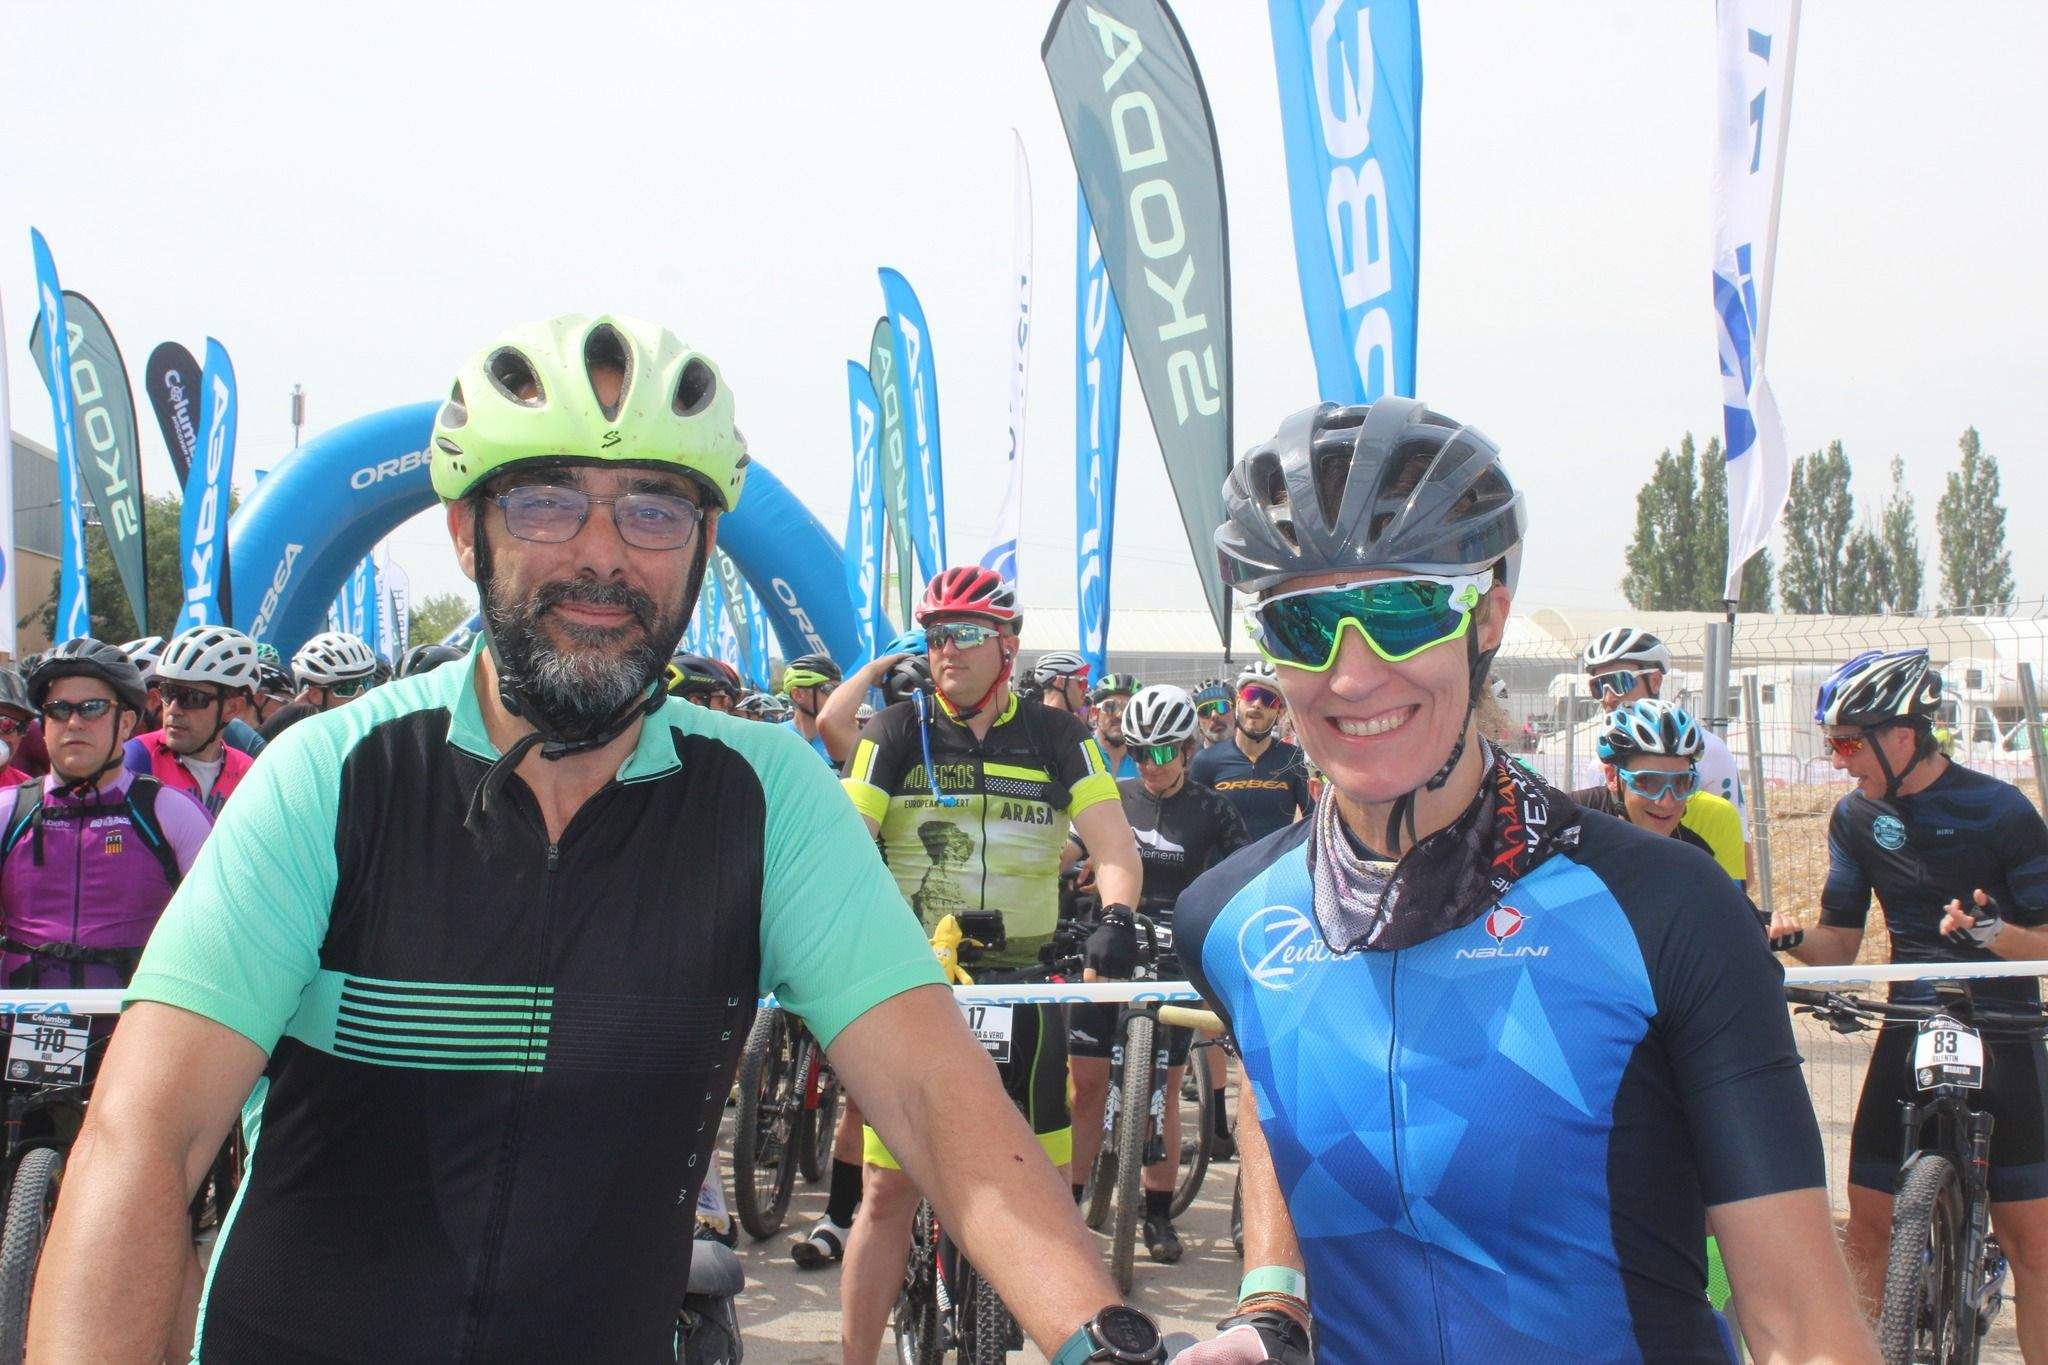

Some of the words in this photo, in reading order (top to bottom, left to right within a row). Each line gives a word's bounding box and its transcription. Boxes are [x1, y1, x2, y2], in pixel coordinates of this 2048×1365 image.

[164, 369, 197, 459] Colum
[248, 543, 304, 641] RBEA
[771, 577, 831, 658] ORB
[1214, 779, 1290, 791] ORBEA
[1000, 802, 1054, 826] ARASA
[1138, 847, 1185, 863] lements
[968, 1006, 986, 1030] 17
[34, 1026, 67, 1054] 170
[1934, 1031, 1958, 1054] 83
